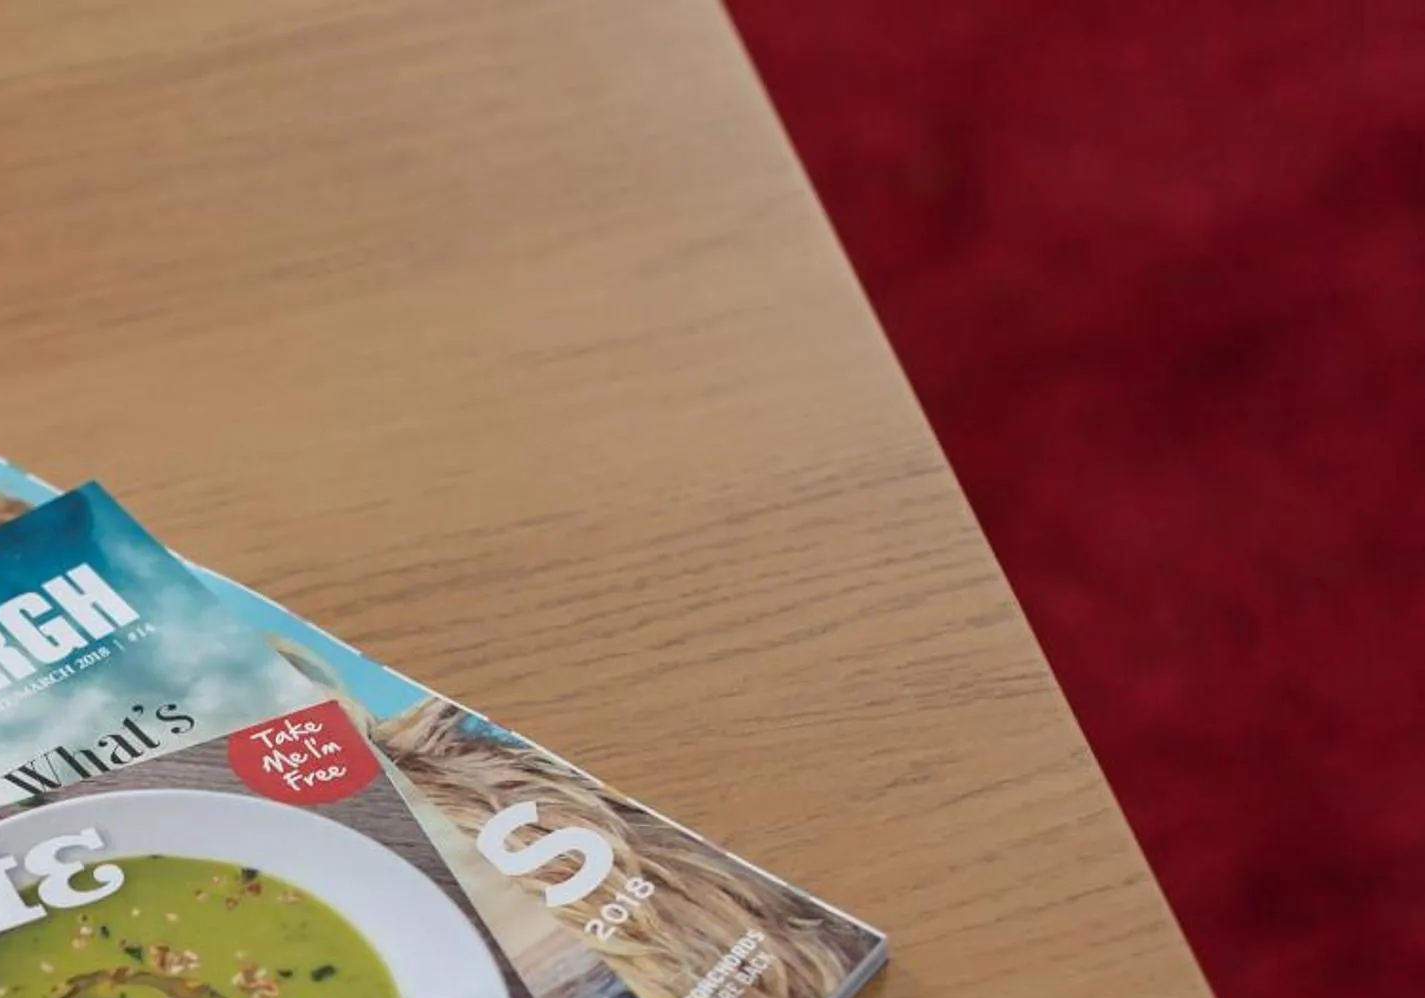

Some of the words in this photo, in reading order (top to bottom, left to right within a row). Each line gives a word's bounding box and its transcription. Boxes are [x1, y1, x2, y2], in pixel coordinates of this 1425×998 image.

[78, 648, 112, 671] 2018
[3, 704, 195, 799] What's
[250, 719, 323, 749] Take
[262, 749, 308, 773] Me
[304, 737, 342, 759] I'm
[282, 766, 347, 791] Free
[477, 801, 614, 907] S
[584, 876, 655, 942] 2018
